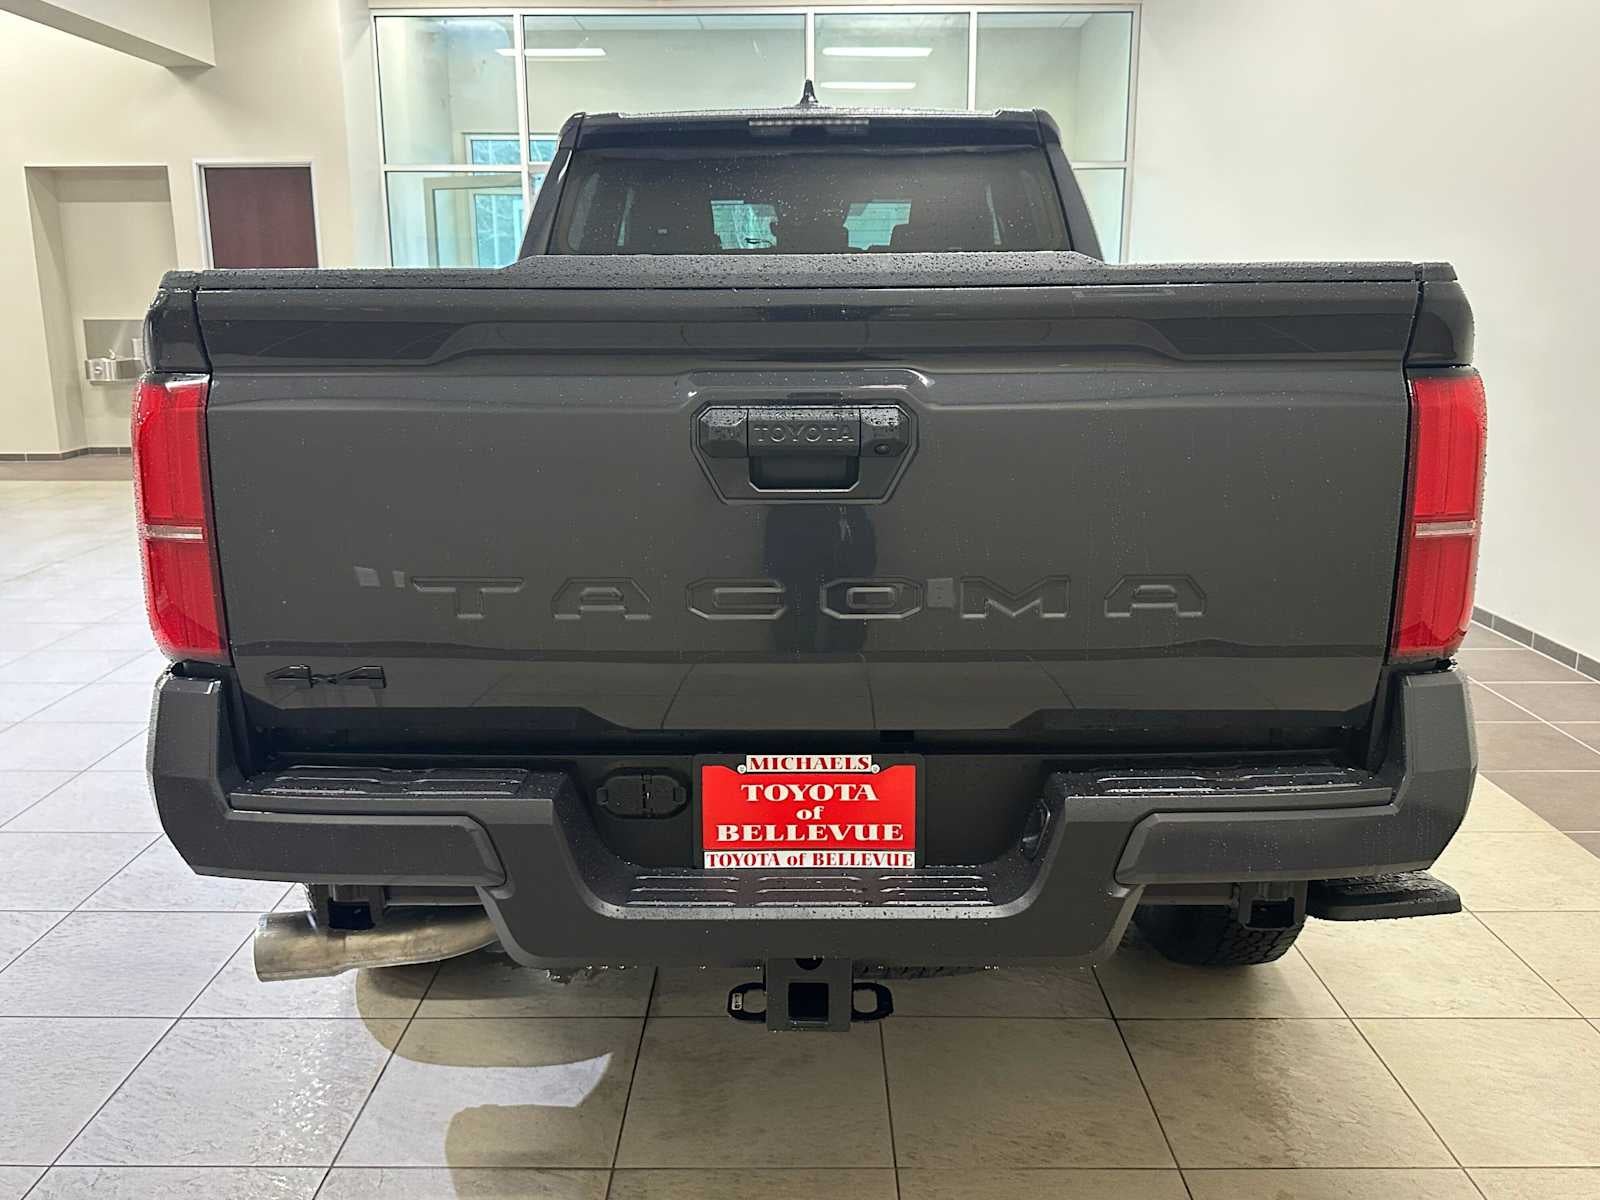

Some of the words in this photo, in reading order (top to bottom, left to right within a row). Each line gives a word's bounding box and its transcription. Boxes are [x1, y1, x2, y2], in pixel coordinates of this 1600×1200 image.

[752, 425, 856, 443] TOYOTA
[411, 575, 1207, 620] TACOMA
[749, 756, 871, 771] MICHAELS
[740, 783, 880, 802] TOYOTA
[796, 805, 825, 820] of
[715, 823, 905, 842] BELLEVUE
[706, 852, 782, 867] TOYOTA
[786, 852, 806, 867] of
[812, 852, 914, 867] BELLEVUE
